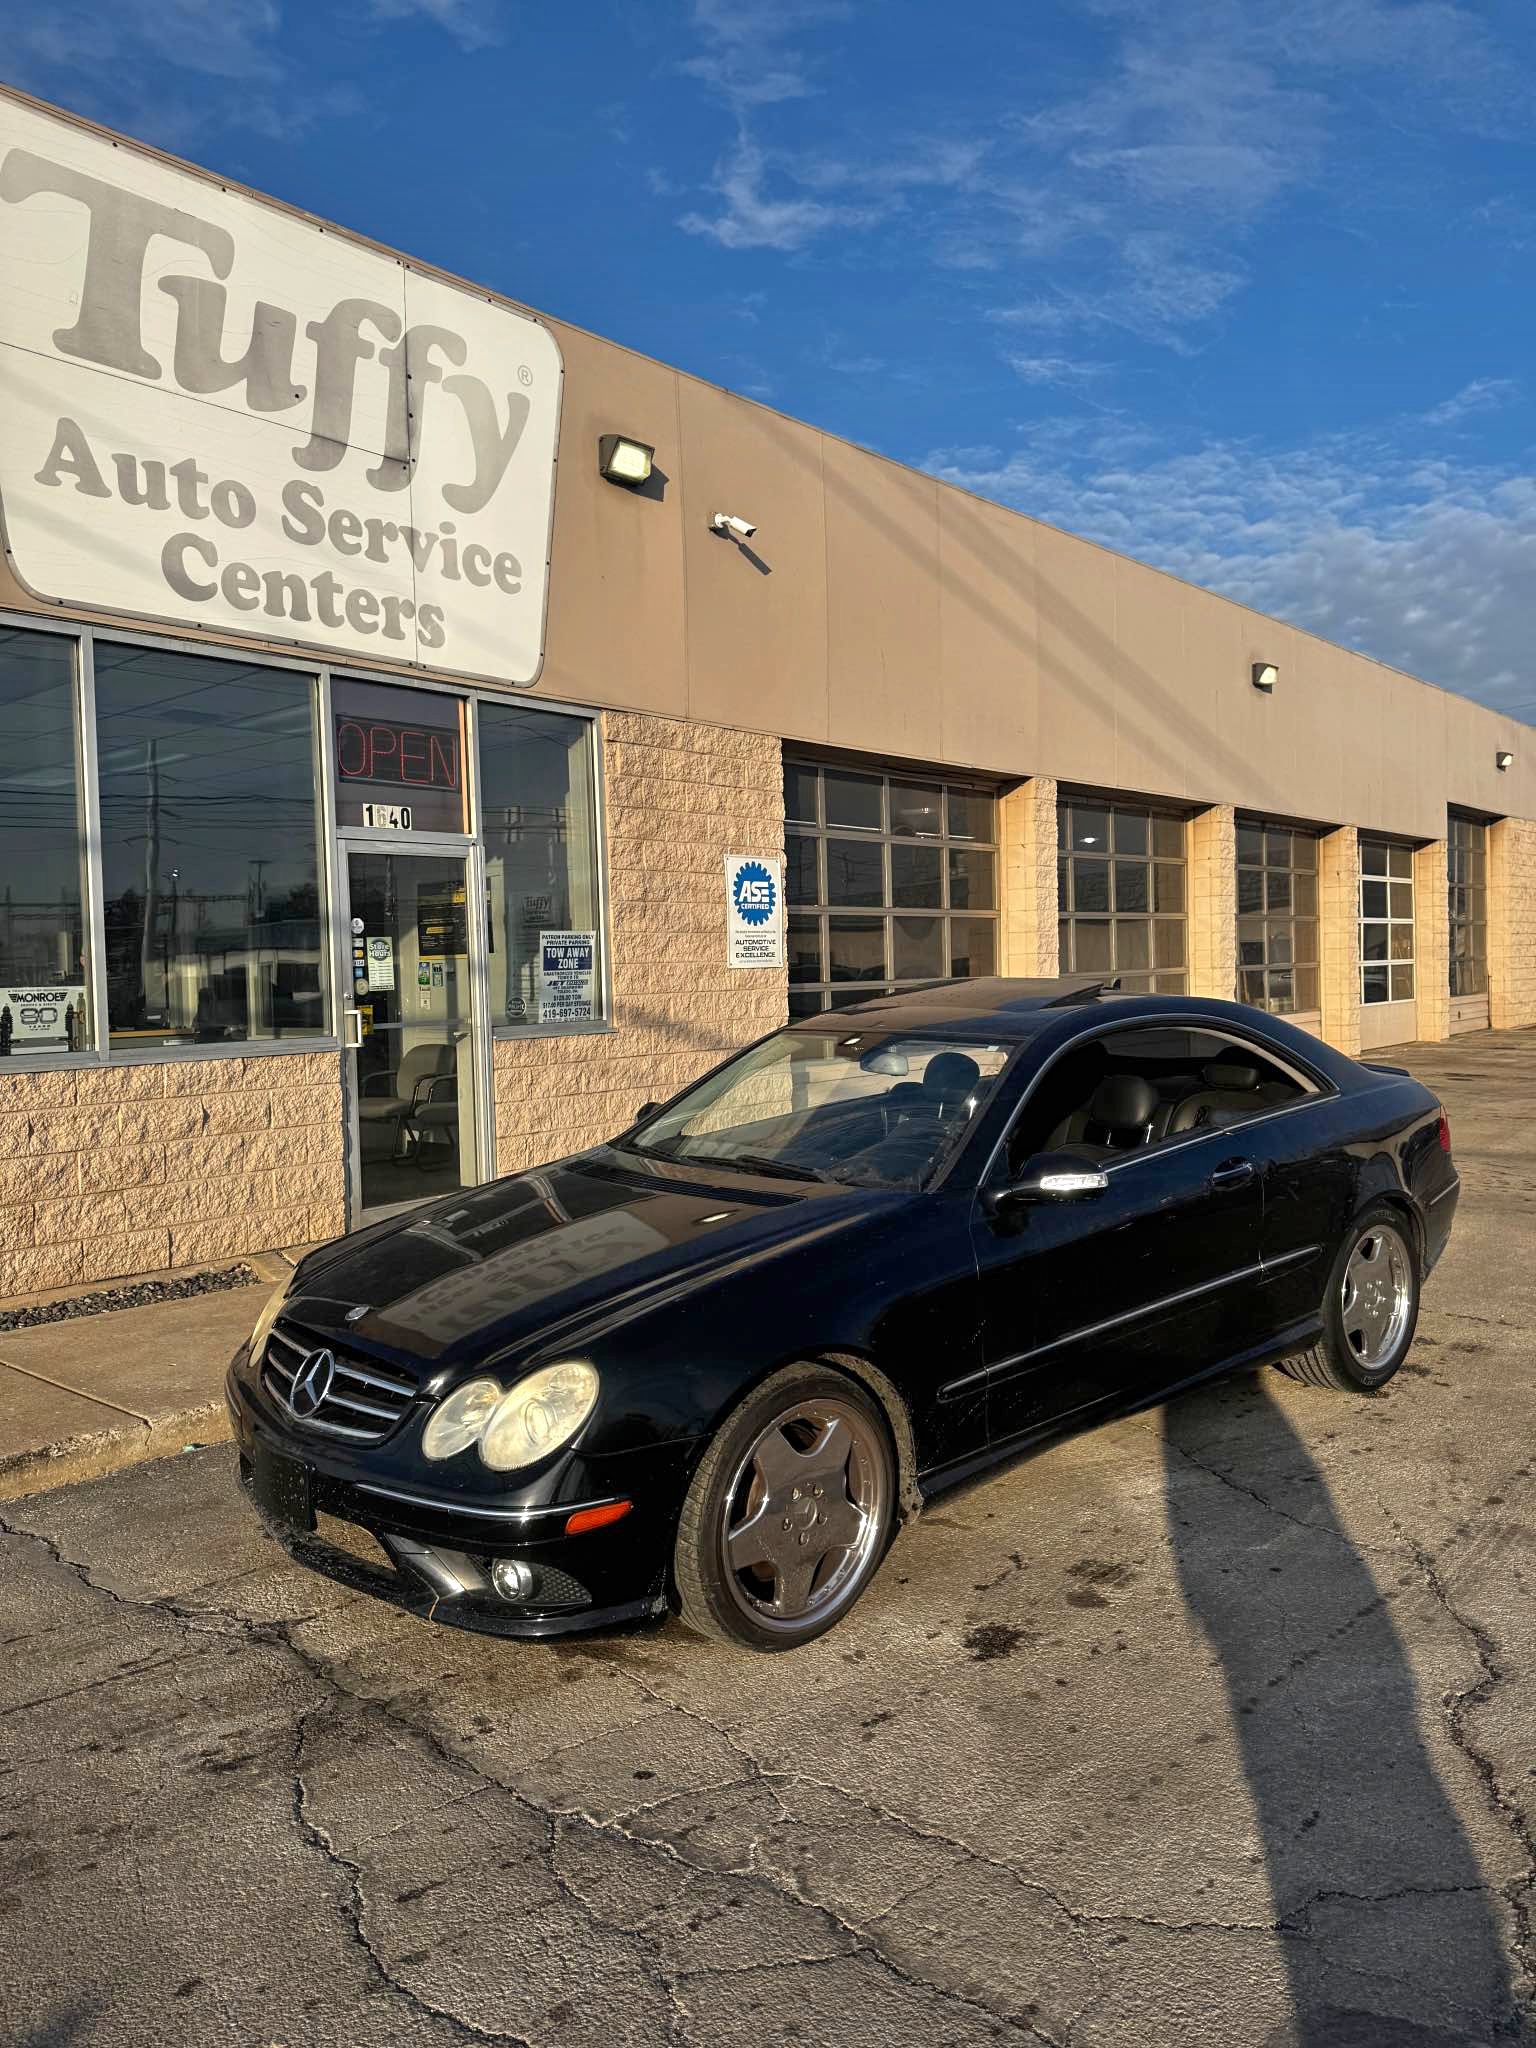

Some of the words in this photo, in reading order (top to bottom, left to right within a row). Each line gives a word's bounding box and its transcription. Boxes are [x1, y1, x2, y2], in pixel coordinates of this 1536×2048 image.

[0, 148, 530, 514] Tuffy
[34, 417, 257, 528] Auto
[281, 480, 522, 594] Service
[161, 533, 445, 648] Centers
[338, 722, 456, 787] OPEN
[738, 880, 770, 903] ASE
[369, 949, 391, 957] Hours
[546, 947, 565, 959] TOW
[567, 947, 590, 958] AWAY
[558, 958, 579, 969] ZONE
[16, 992, 60, 1002] MONROE
[543, 1007, 591, 1018] 419-697-5724
